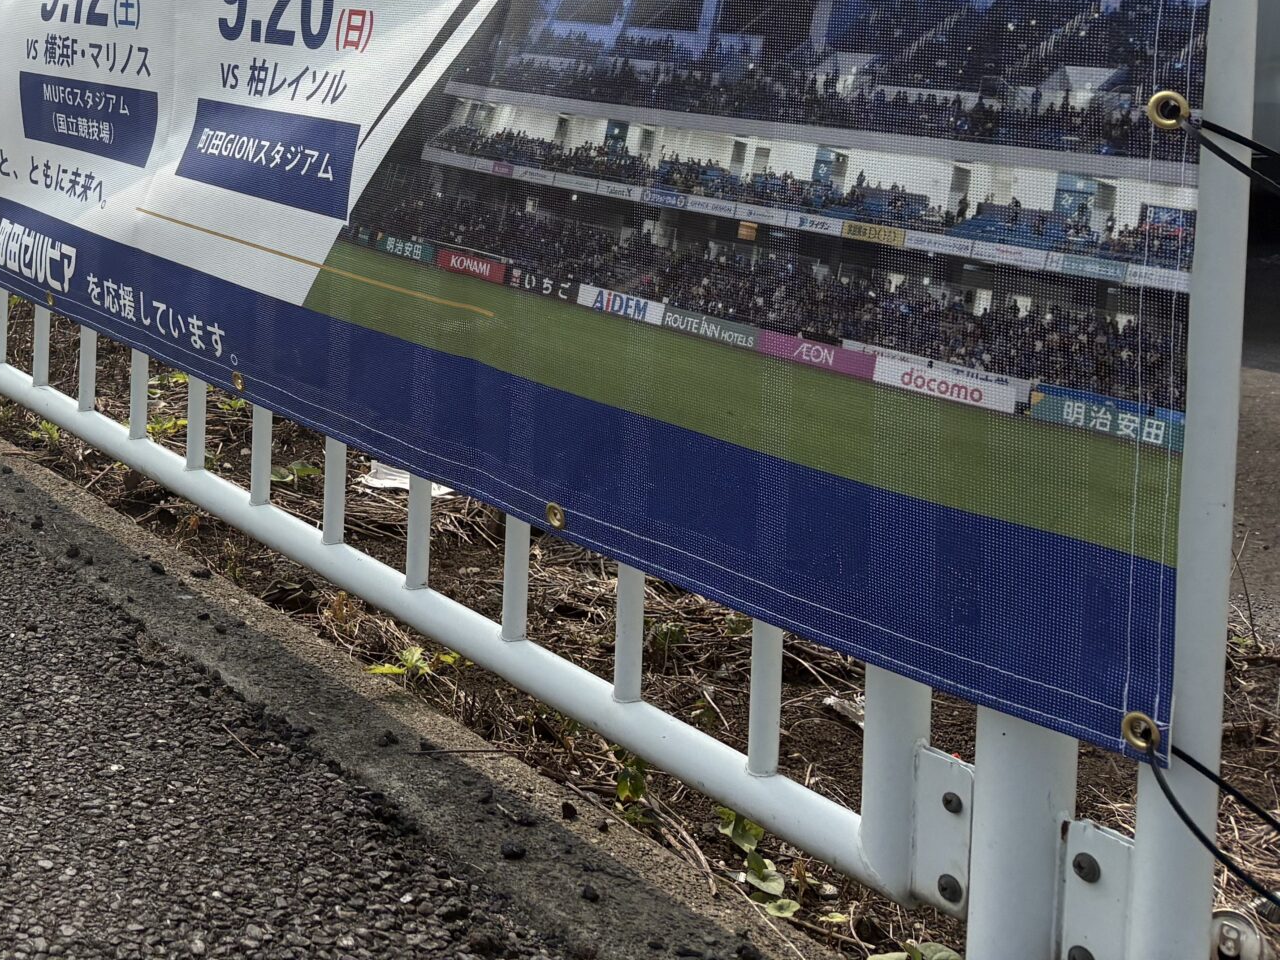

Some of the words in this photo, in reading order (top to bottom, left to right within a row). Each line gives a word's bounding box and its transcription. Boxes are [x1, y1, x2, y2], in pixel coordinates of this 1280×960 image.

[44, 32, 151, 78] 横浜F・マリノス
[247, 56, 348, 106] 柏レイソル
[43, 83, 130, 116] MUFGスタジアム
[197, 127, 334, 182] 町田GIONスタジアム
[386, 237, 423, 260] 明治安田
[450, 255, 491, 277] KONAMI
[524, 273, 574, 300] いちご
[87, 272, 238, 366] を応援しています。
[665, 312, 700, 334] ROUTE
[720, 330, 754, 348] HOTELS
[901, 368, 984, 404] docomo
[1062, 401, 1166, 445] 明治安田
